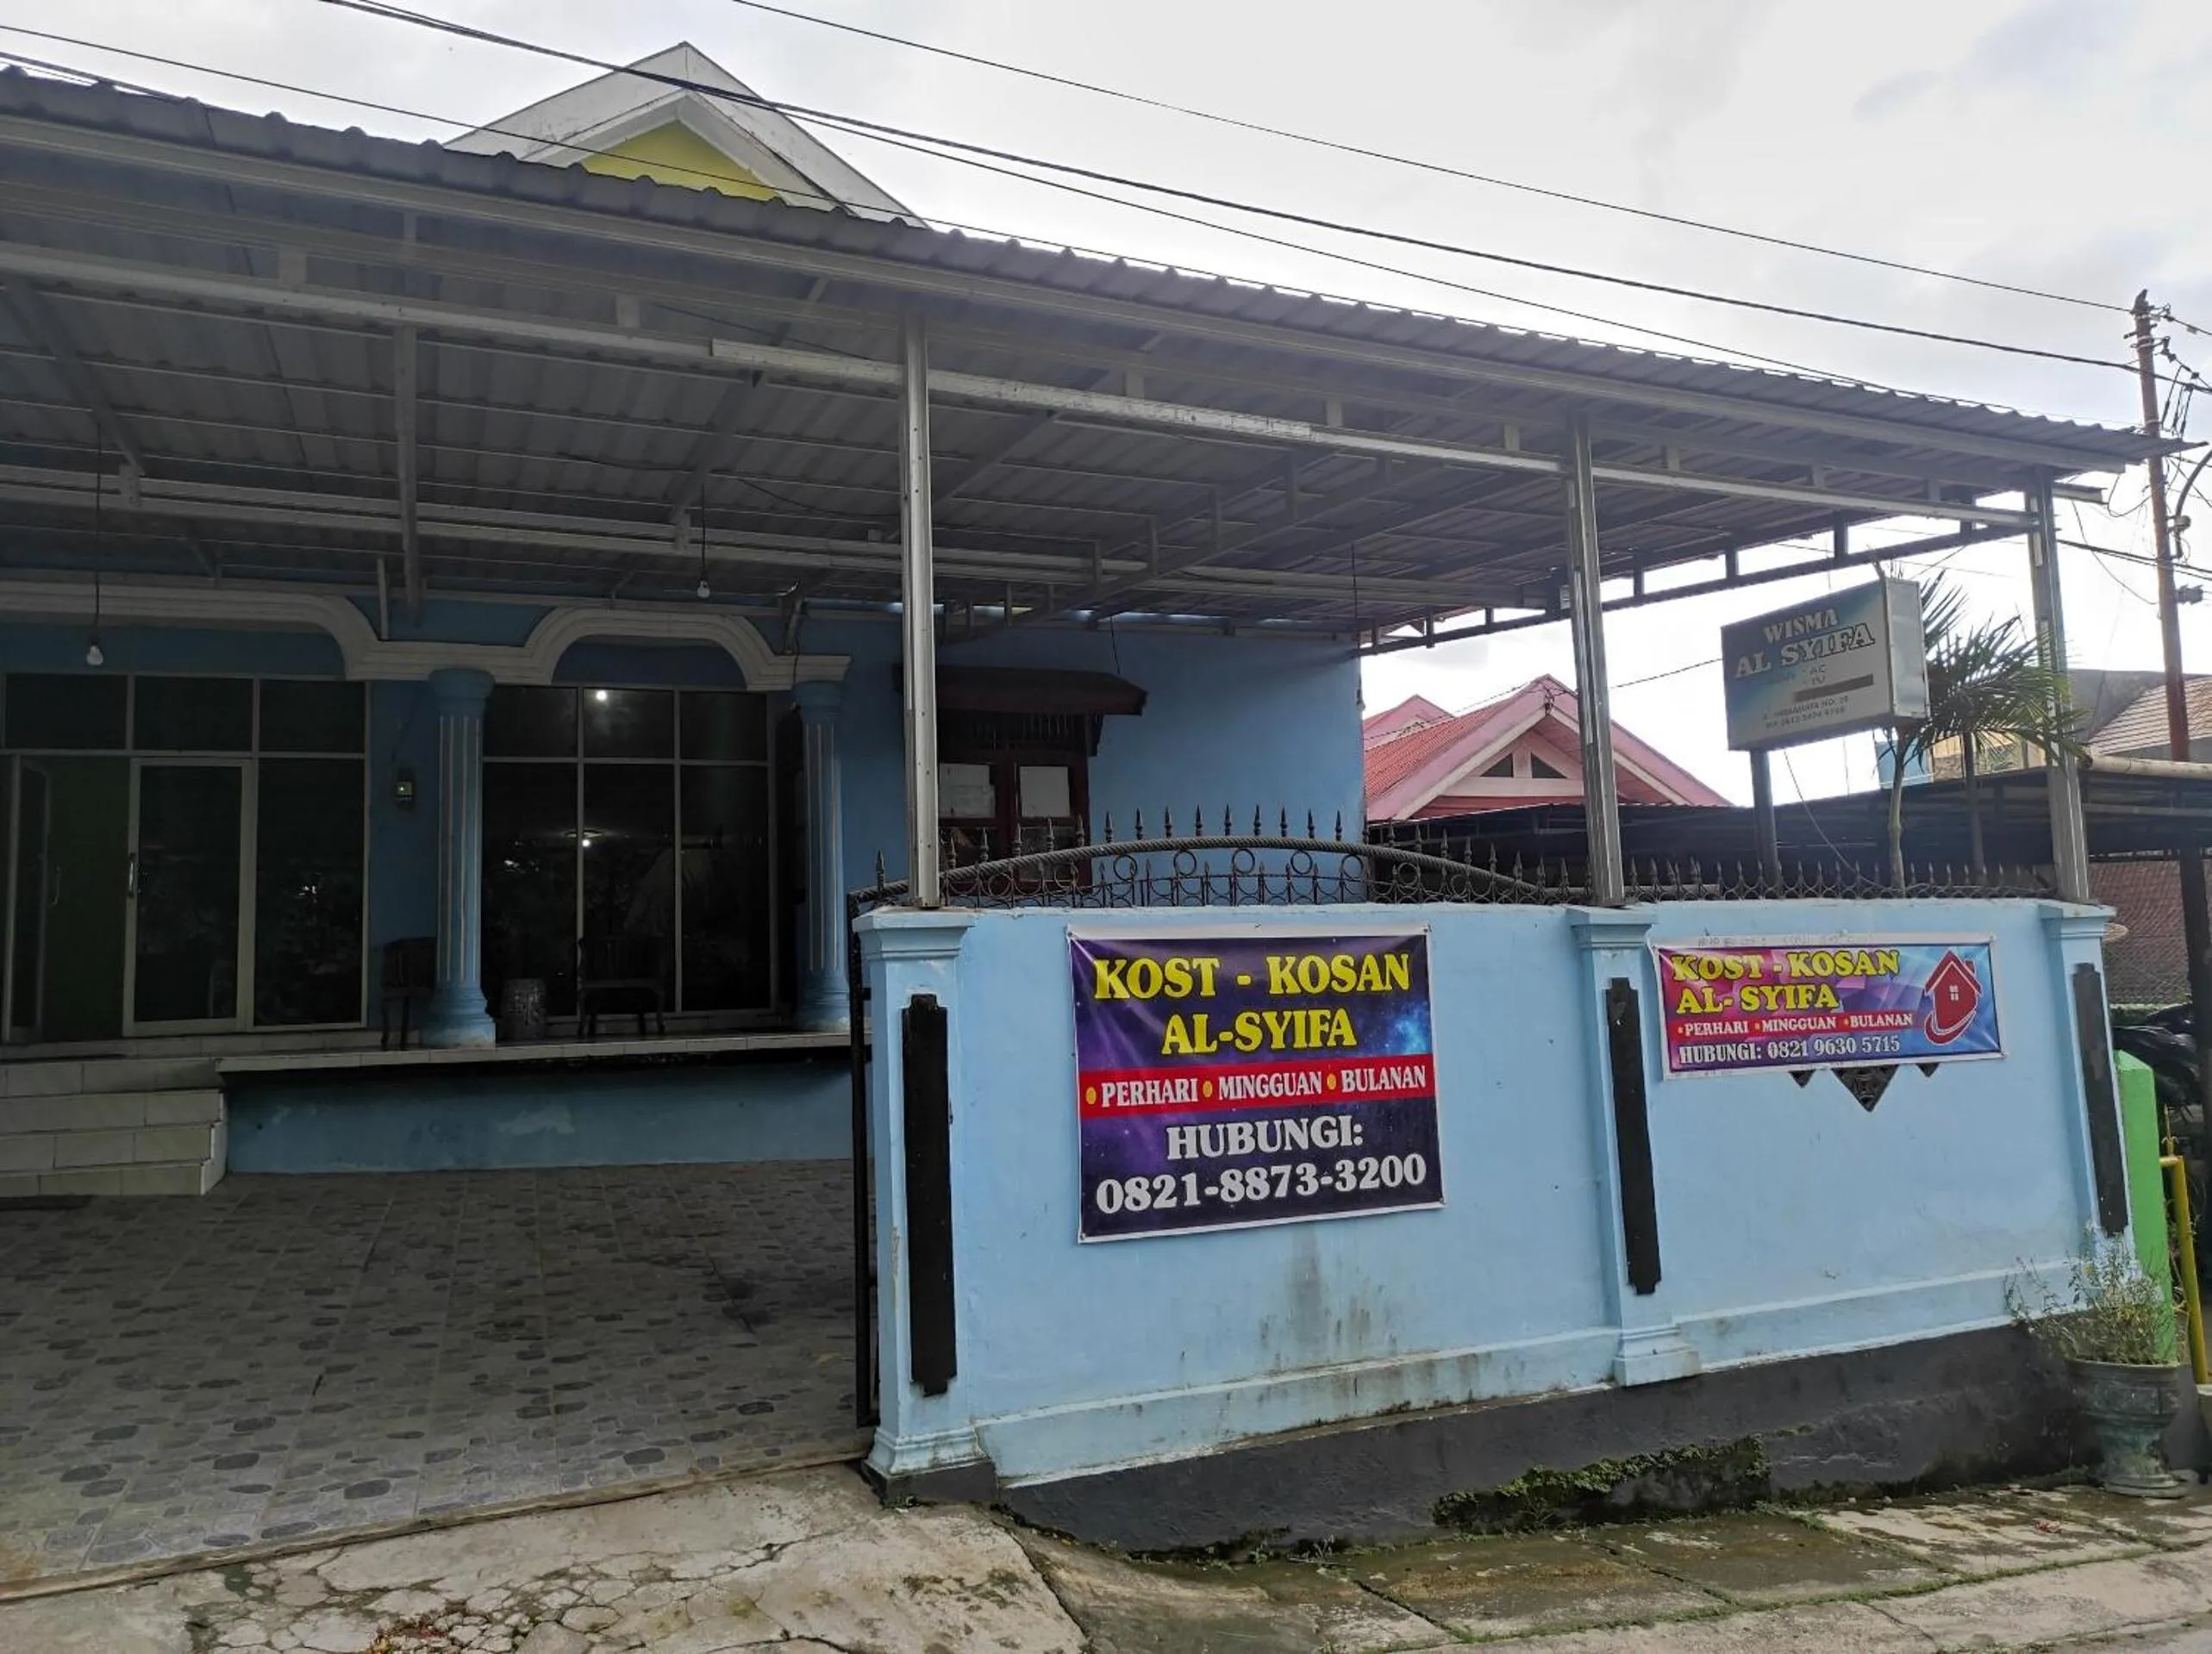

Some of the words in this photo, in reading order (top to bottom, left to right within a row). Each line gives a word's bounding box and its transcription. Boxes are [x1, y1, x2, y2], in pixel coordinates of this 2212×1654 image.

[1764, 609, 1838, 643] WISMA
[1735, 652, 1771, 678] AL
[1781, 622, 1876, 666] SYIFA
[1094, 957, 1220, 1000] KOST
[1266, 953, 1410, 996] KOSAN
[1671, 952, 1764, 982] KOST
[1788, 949, 1901, 978] KOSAN
[1161, 1007, 1357, 1055] AL-SYIFA
[1684, 1020, 1749, 1037] PERHARI
[1762, 1016, 1837, 1033] MINGGUAN
[1849, 1013, 1913, 1028] BULANAN
[1678, 1042, 1762, 1065] HUBUNGI:
[1767, 1040, 1808, 1060] 0821
[1814, 1037, 1857, 1057] 9630
[1861, 1036, 1901, 1053] 5715
[1102, 1077, 1198, 1108] PERHARI
[1218, 1071, 1322, 1100] MINGGUAN
[1340, 1065, 1427, 1093] BULANAN
[1166, 1115, 1365, 1160] HUBUNGI:
[1096, 1153, 1428, 1214] 0821-8873-3200
